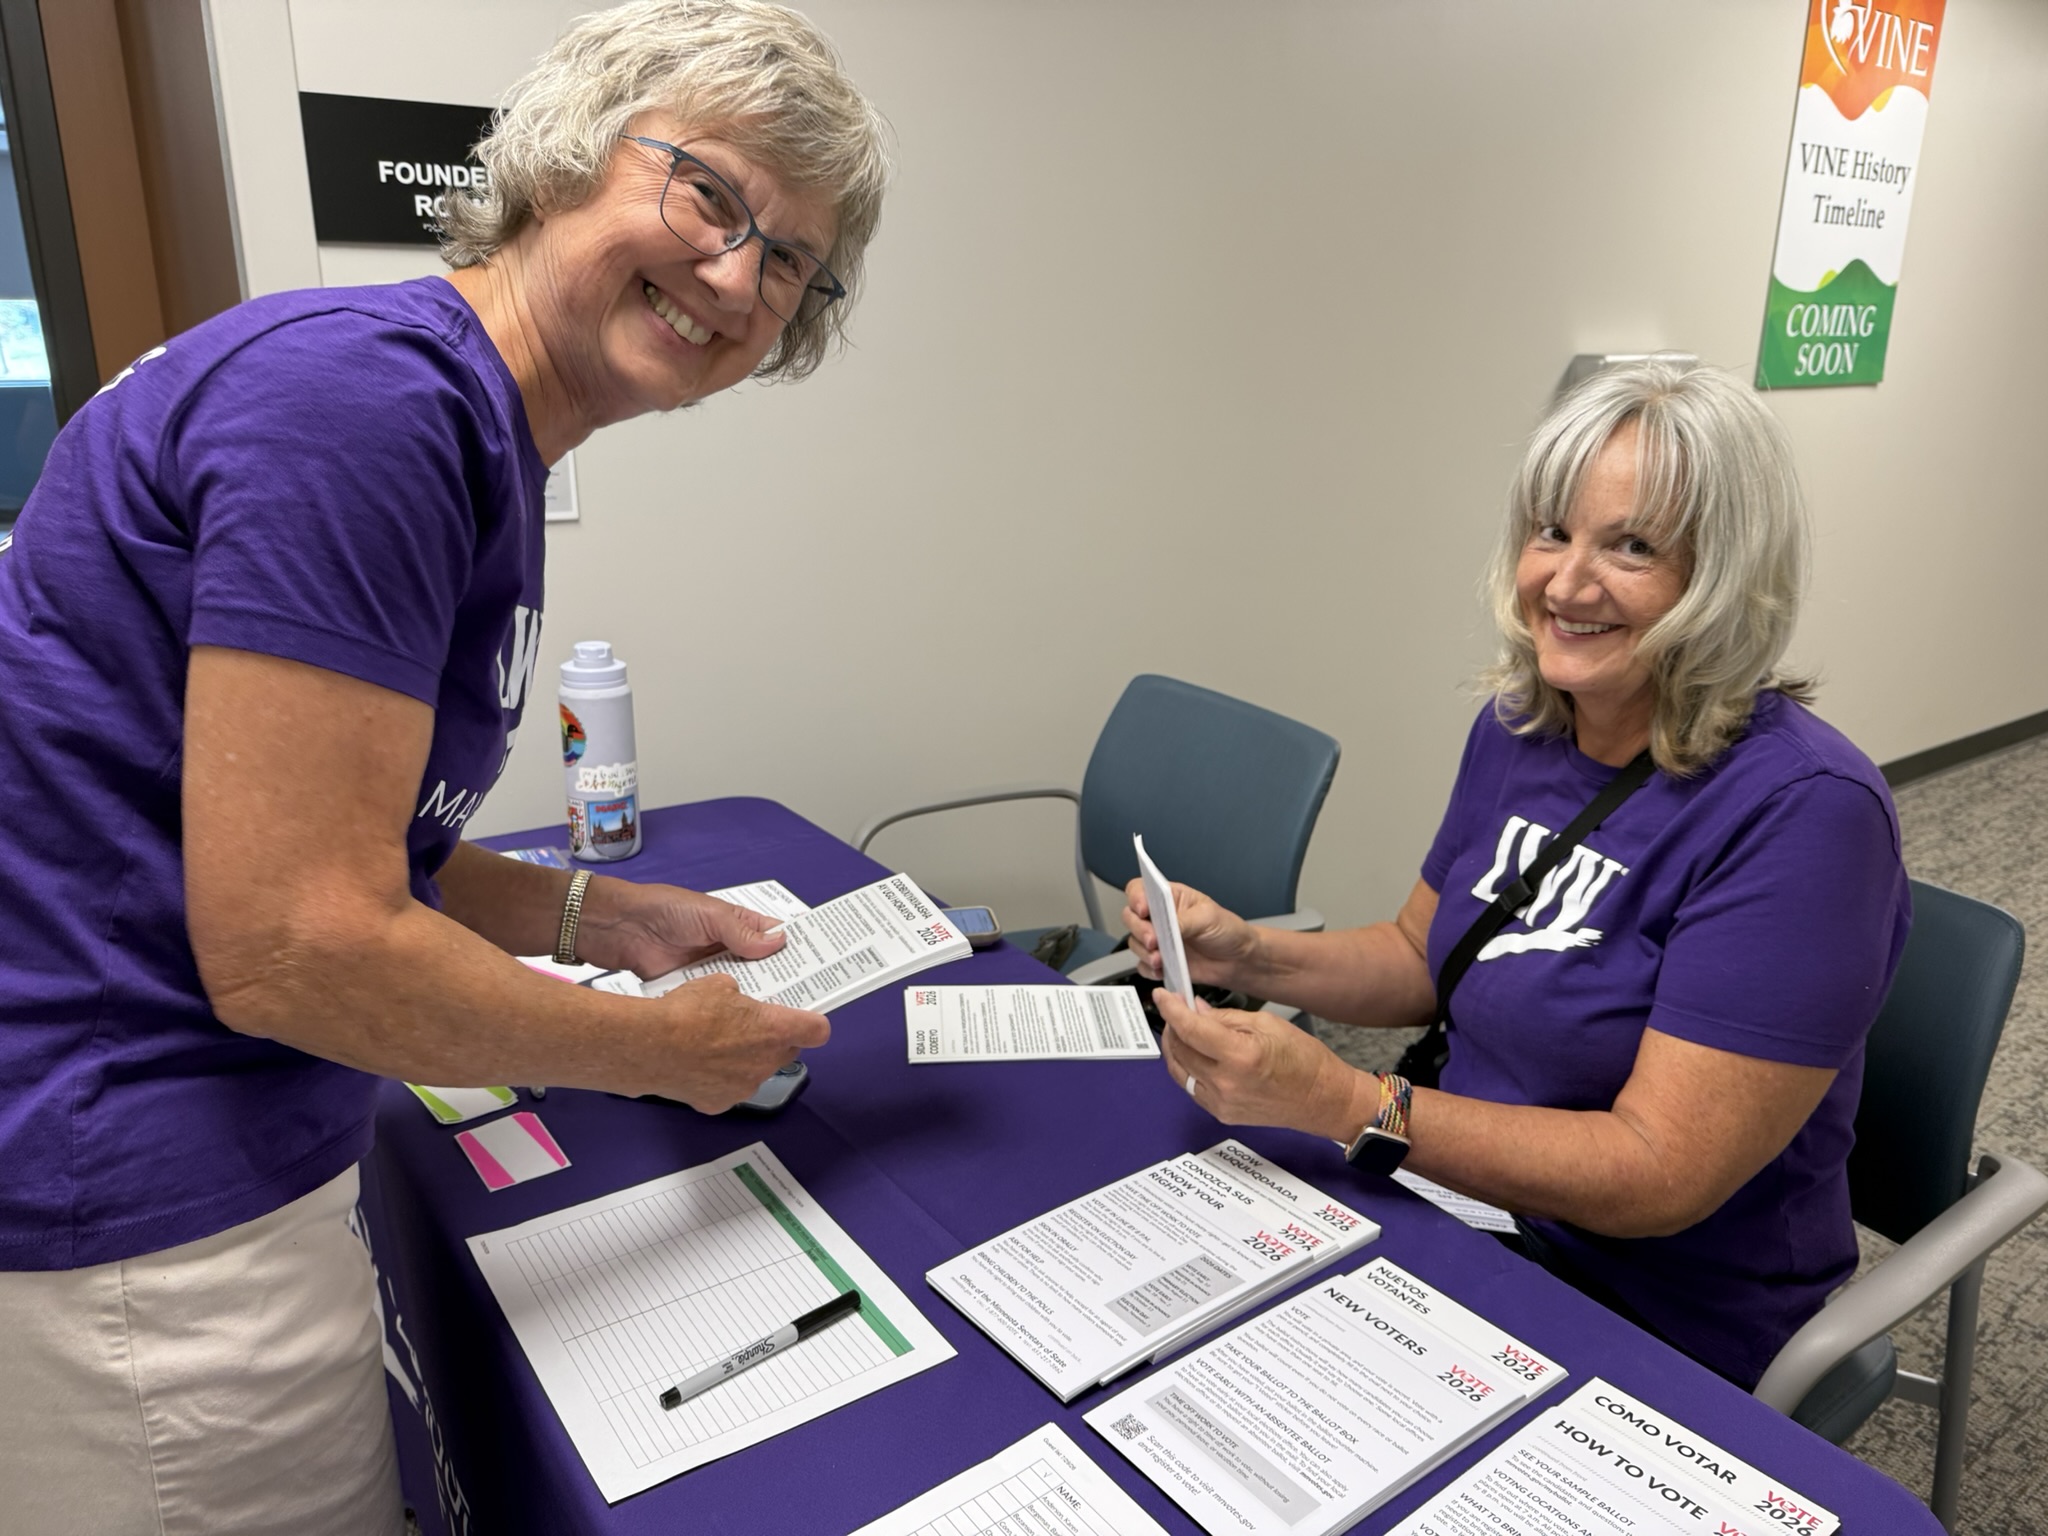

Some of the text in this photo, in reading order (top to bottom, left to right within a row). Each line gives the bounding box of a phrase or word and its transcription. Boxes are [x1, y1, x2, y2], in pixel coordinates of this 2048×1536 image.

[1850, 4, 1934, 77] VINE
[378, 160, 493, 188] FOUNDE
[1800, 143, 1911, 194] VINE History
[1813, 194, 1885, 230] Timeline
[1786, 303, 1877, 338] COMING
[1795, 342, 1858, 376] SOON
[1226, 1145, 1264, 1167] OGOW
[1148, 1171, 1186, 1197] RIGHTS
[1159, 1166, 1196, 1189] KNOW
[1194, 1188, 1224, 1210] YOUR
[1181, 1160, 1232, 1192] CONOZCA
[1231, 1190, 1254, 1204] SUS
[1312, 1209, 1352, 1231] 2026
[1325, 1203, 1361, 1228] VOTE
[1242, 1236, 1285, 1261] 2026
[1256, 1229, 1295, 1256] VOTE
[1287, 1222, 1323, 1247] VOTE
[1366, 1271, 1430, 1314] VOTANTES
[1375, 1265, 1428, 1299] NUEVOS
[959, 1273, 976, 1289] Office
[980, 1292, 991, 1302] the
[989, 1300, 1018, 1326] Minnesota
[1016, 1324, 1045, 1348] Secretary
[1049, 1352, 1066, 1368] State
[1290, 1305, 1311, 1320] VOTE
[1323, 1287, 1427, 1355] NEW VOTERS
[1491, 1351, 1539, 1380] 2026
[1504, 1344, 1548, 1375] VOTE
[1224, 1342, 1359, 1444] TAKE YOUR BALLOT TO THE BALLOT BOX
[1436, 1371, 1485, 1401] 2026
[1450, 1364, 1495, 1396] VOTE
[1169, 1391, 1239, 1449] TIME OFF WORK TO VOTE
[1195, 1357, 1332, 1463] VOTE EARLY WITH AN ABSENTEE BALLOT
[1594, 1395, 1736, 1484] CÓMO VOTAR
[1137, 1441, 1201, 1495] and register to vote!
[1146, 1434, 1256, 1530] Scan this code to visit mnvotes.gov
[1554, 1419, 1708, 1520] HOW TO VOTE
[1056, 1485, 1081, 1510] NAME:
[1493, 1467, 1580, 1529] VOTING LOCATIONS
[1517, 1449, 1635, 1526] SEE YOUR SAMPLE BALLOT
[1460, 1492, 1489, 1513] WHAT
[1487, 1511, 1501, 1523] TO
[1753, 1499, 1813, 1536] 2026
[1767, 1490, 1823, 1530] VOTE
